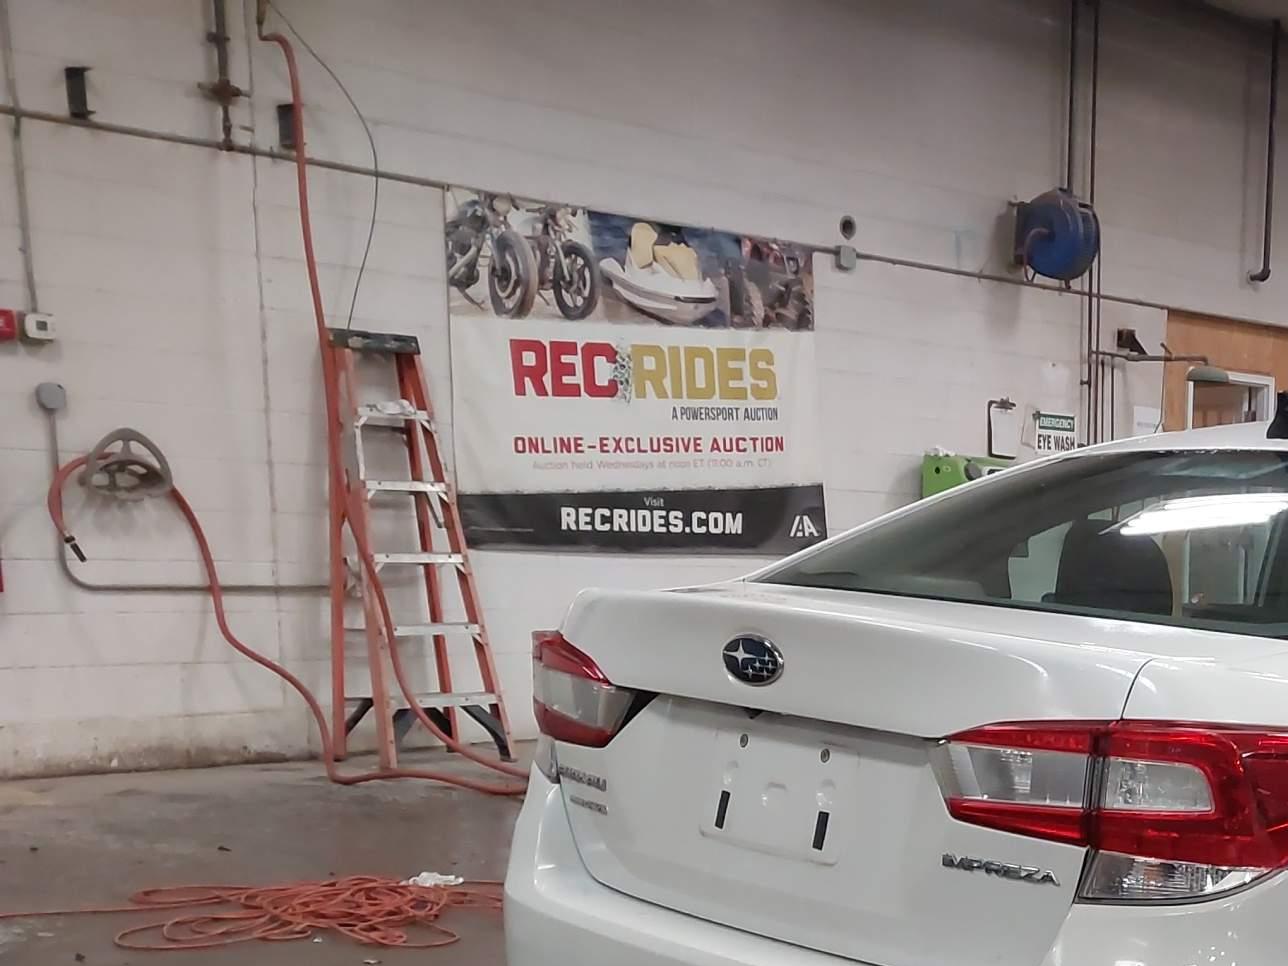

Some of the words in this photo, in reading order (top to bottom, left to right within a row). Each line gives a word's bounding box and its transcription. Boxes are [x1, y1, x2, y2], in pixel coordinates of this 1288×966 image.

[509, 338, 619, 398] REC
[631, 343, 779, 401] RIDES
[672, 407, 679, 421] A
[680, 407, 740, 421] POWERSPORT
[743, 407, 779, 421] AUCTION
[1040, 416, 1074, 431] EMERGENCY
[514, 436, 703, 454] ONLINE-EXCLUSIVE
[710, 436, 785, 453] AUCTION
[1037, 433, 1052, 450] EYE
[1053, 434, 1076, 451] WASH
[644, 497, 665, 507] Visit
[560, 506, 744, 536] RECRIDES.COM
[942, 853, 1060, 886] IMPREZA
